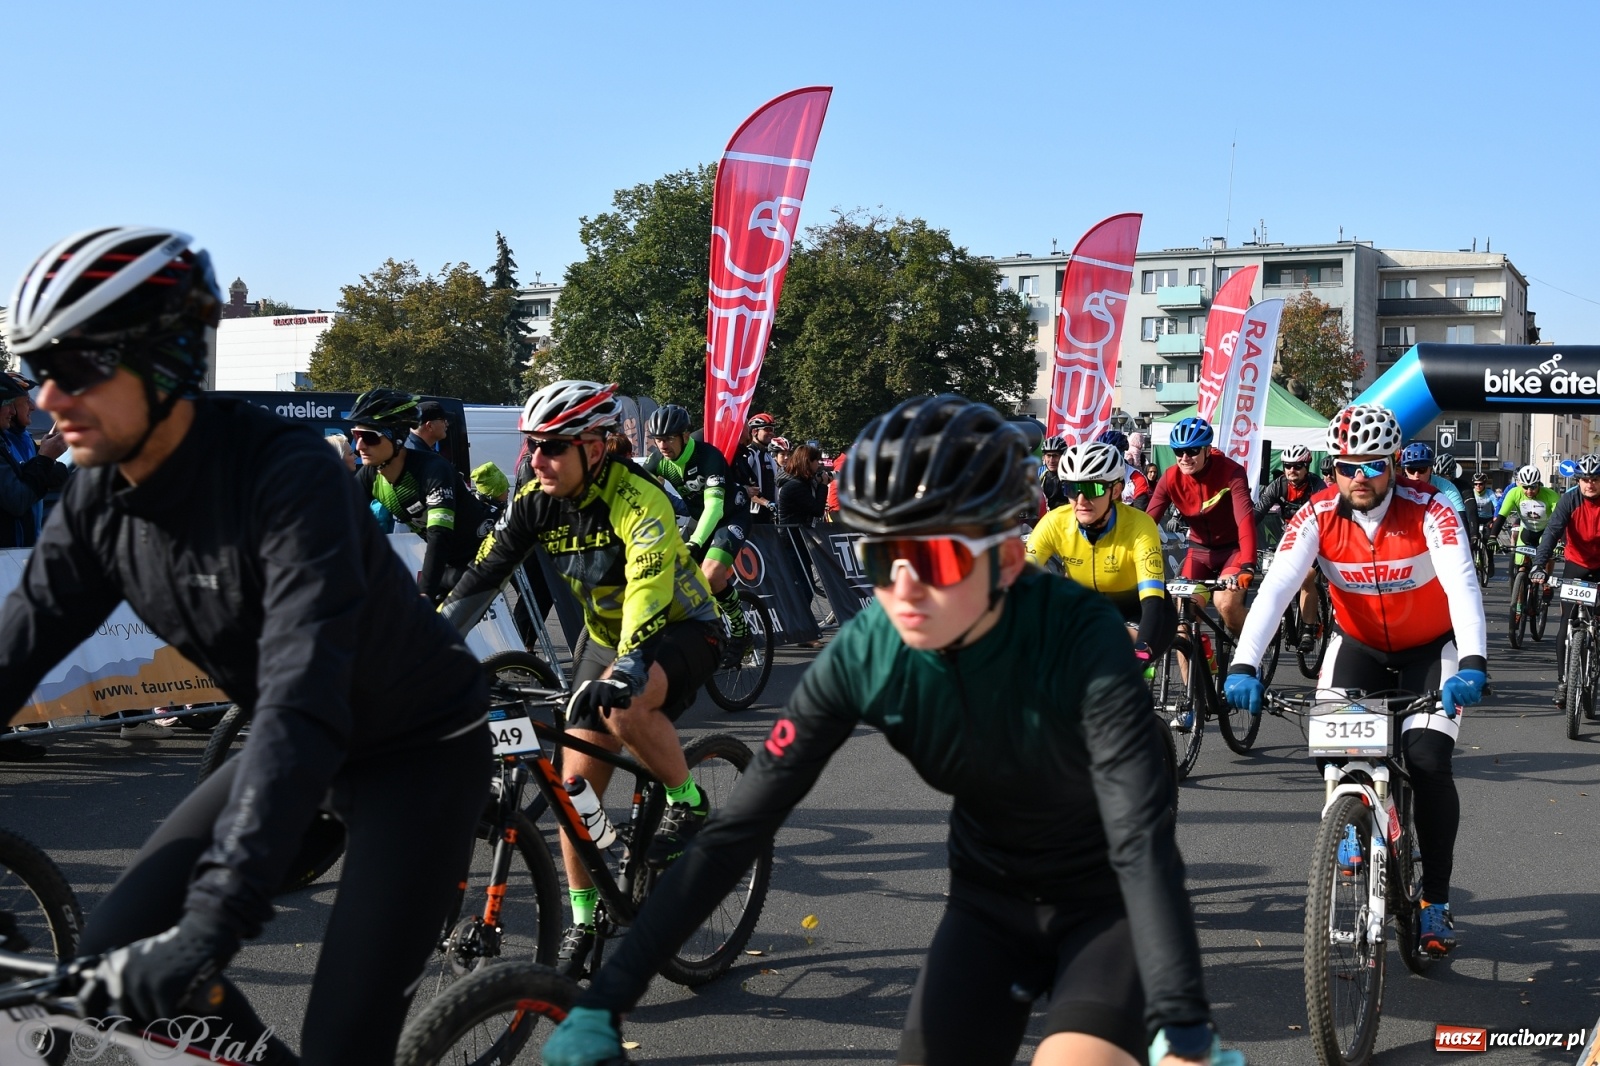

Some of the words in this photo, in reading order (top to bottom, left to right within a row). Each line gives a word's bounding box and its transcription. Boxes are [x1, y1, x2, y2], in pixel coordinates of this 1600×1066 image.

[1484, 368, 1542, 394] bike
[276, 401, 335, 418] atelier
[1340, 565, 1413, 583] RAFAKO
[1567, 587, 1592, 598] 3160
[1325, 721, 1376, 738] 3145
